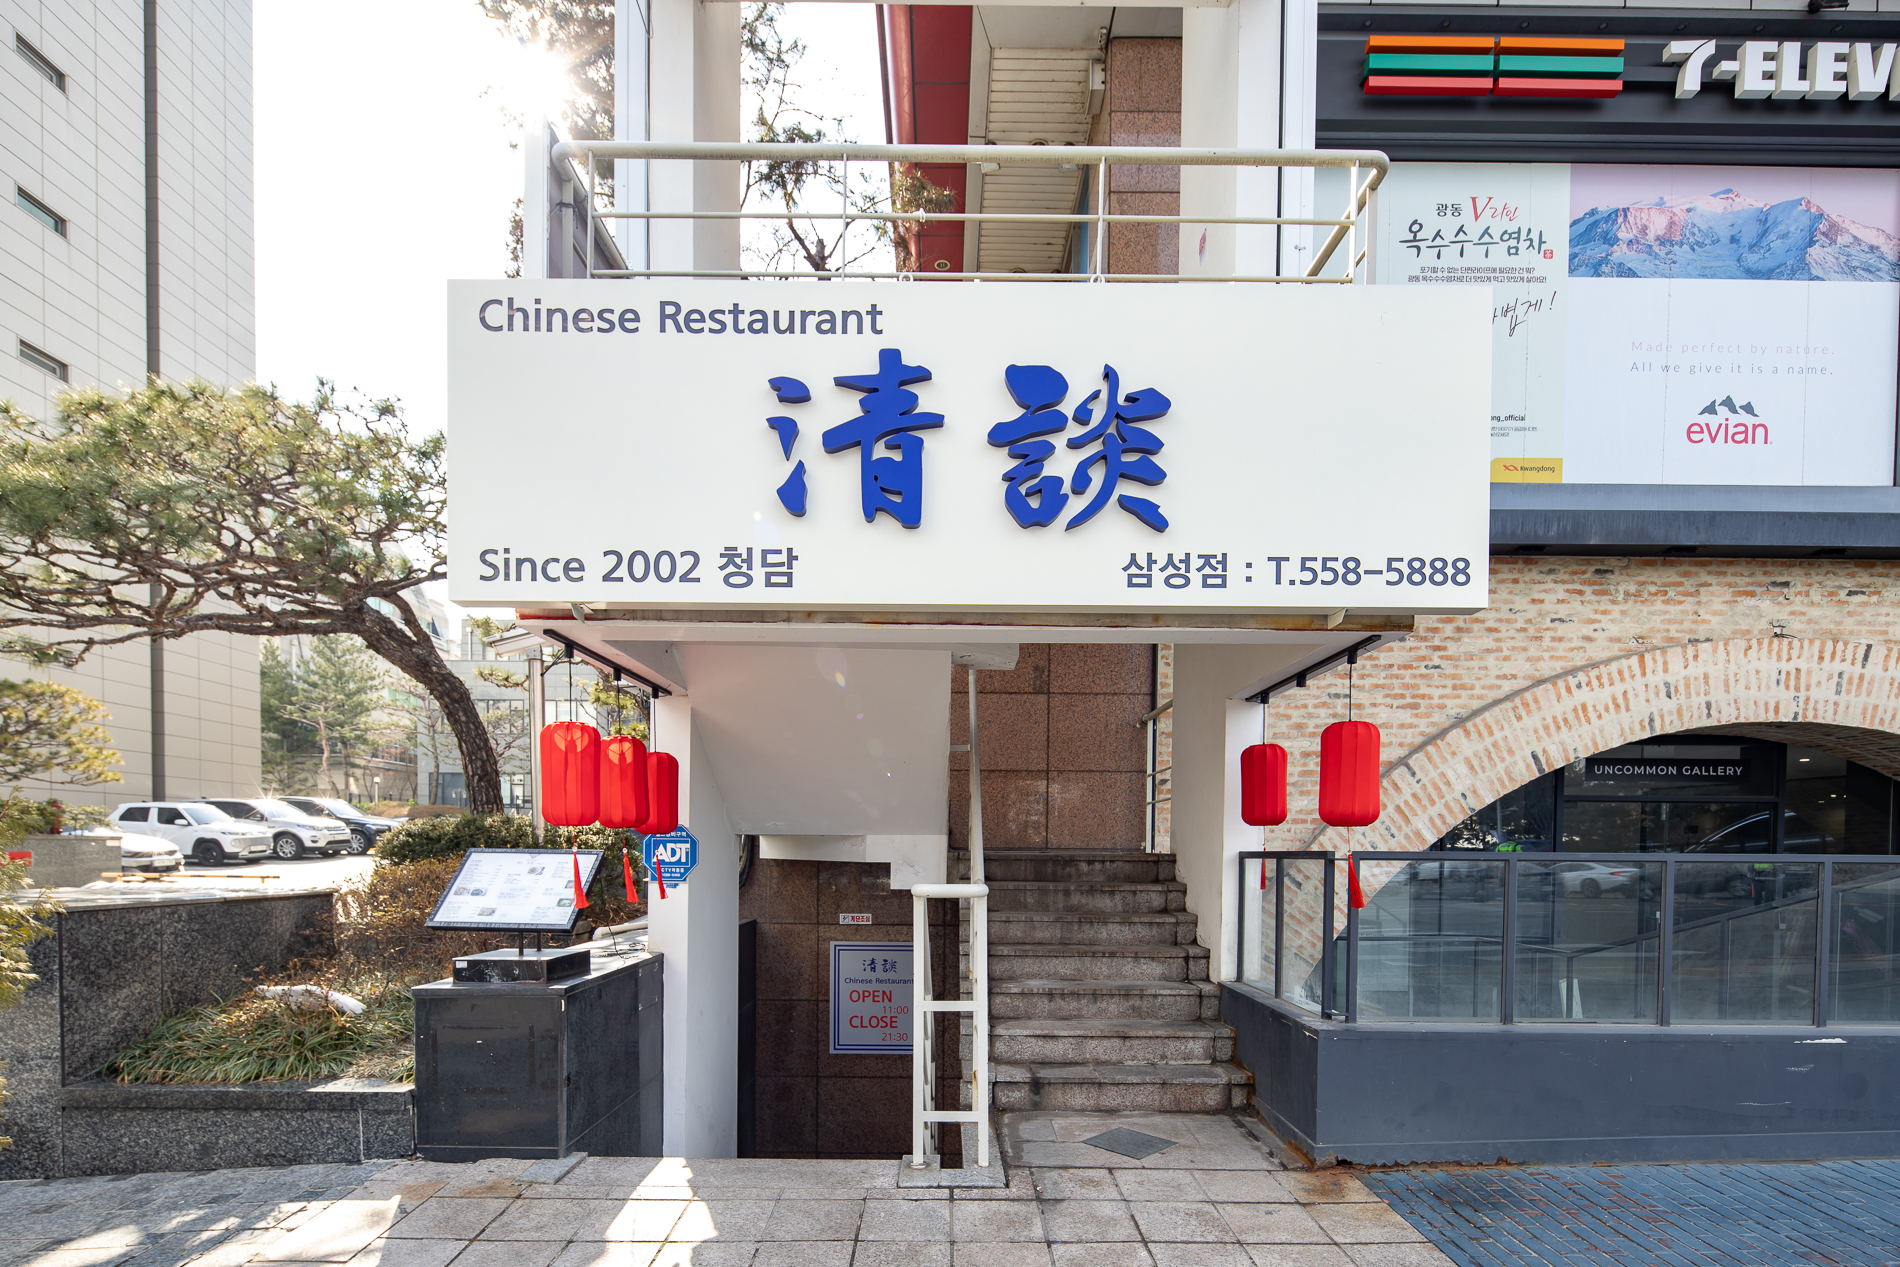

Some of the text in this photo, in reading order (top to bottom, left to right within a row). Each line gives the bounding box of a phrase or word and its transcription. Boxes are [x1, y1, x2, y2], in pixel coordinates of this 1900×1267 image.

[1663, 39, 1900, 101] 7-ELEV
[1436, 203, 1463, 217] 광동
[1399, 219, 1547, 260] 옥수수수염차
[1499, 267, 1517, 275] 필요한
[1408, 275, 1420, 283] 광동
[479, 297, 883, 334] Chinese Restaurant
[1631, 341, 1835, 355] Made perfect by nature.
[1630, 362, 1833, 375] All we give it is a name.
[1686, 418, 1769, 445] evian
[766, 348, 1171, 533] 清談
[1520, 465, 1556, 473] Kwangdong
[480, 547, 798, 588] Since 2002 청담
[1122, 553, 1227, 589] 삼성점
[1268, 556, 1471, 587] T.558-5888
[1594, 765, 1743, 776] UNCOMMON GALLERY
[652, 843, 690, 863] ADT
[850, 915, 871, 923] 계단조심
[862, 957, 898, 973] 清談
[875, 977, 914, 985] Restaurant
[849, 990, 893, 1003] OPEN
[882, 1006, 909, 1014] 11:00
[849, 1015, 898, 1029] CLOSE
[881, 1033, 908, 1041] 21:30
